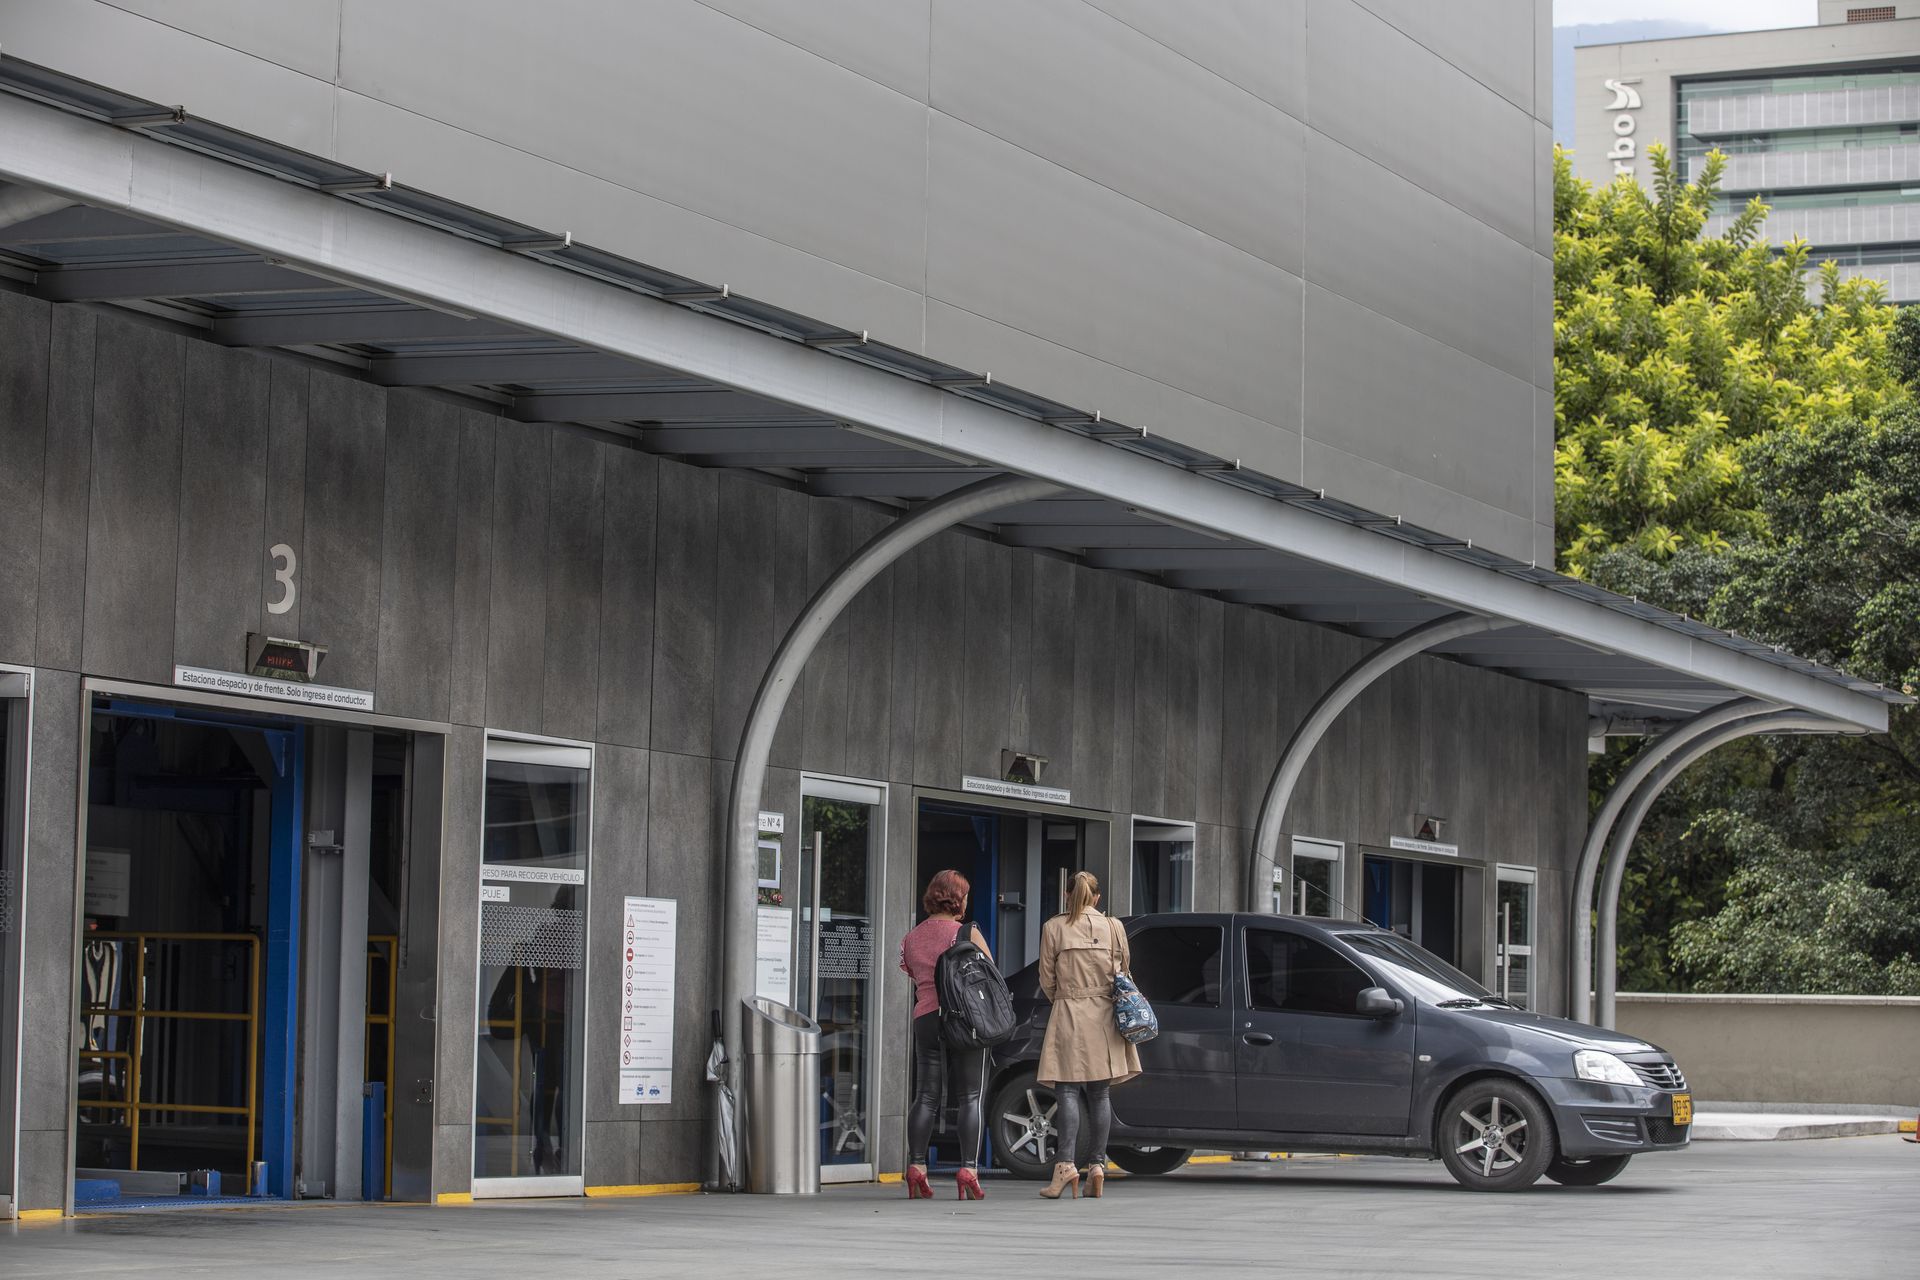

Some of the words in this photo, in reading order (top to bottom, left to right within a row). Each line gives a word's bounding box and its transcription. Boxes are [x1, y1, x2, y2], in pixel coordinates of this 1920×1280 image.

[267, 543, 297, 615] 3
[182, 671, 216, 686] Estaciona
[216, 676, 248, 692] despacio
[248, 682, 254, 693] y
[253, 680, 263, 692] de
[264, 682, 285, 696] frente.
[286, 686, 301, 697] Solo
[302, 688, 326, 703] ingresa
[327, 691, 333, 701] el
[334, 693, 367, 706] conductor.
[776, 818, 780, 828] 4
[501, 869, 518, 879] PARA
[518, 870, 548, 880] RECOGER
[549, 871, 580, 882] VEHÍCULO
[482, 889, 501, 899] PUJE
